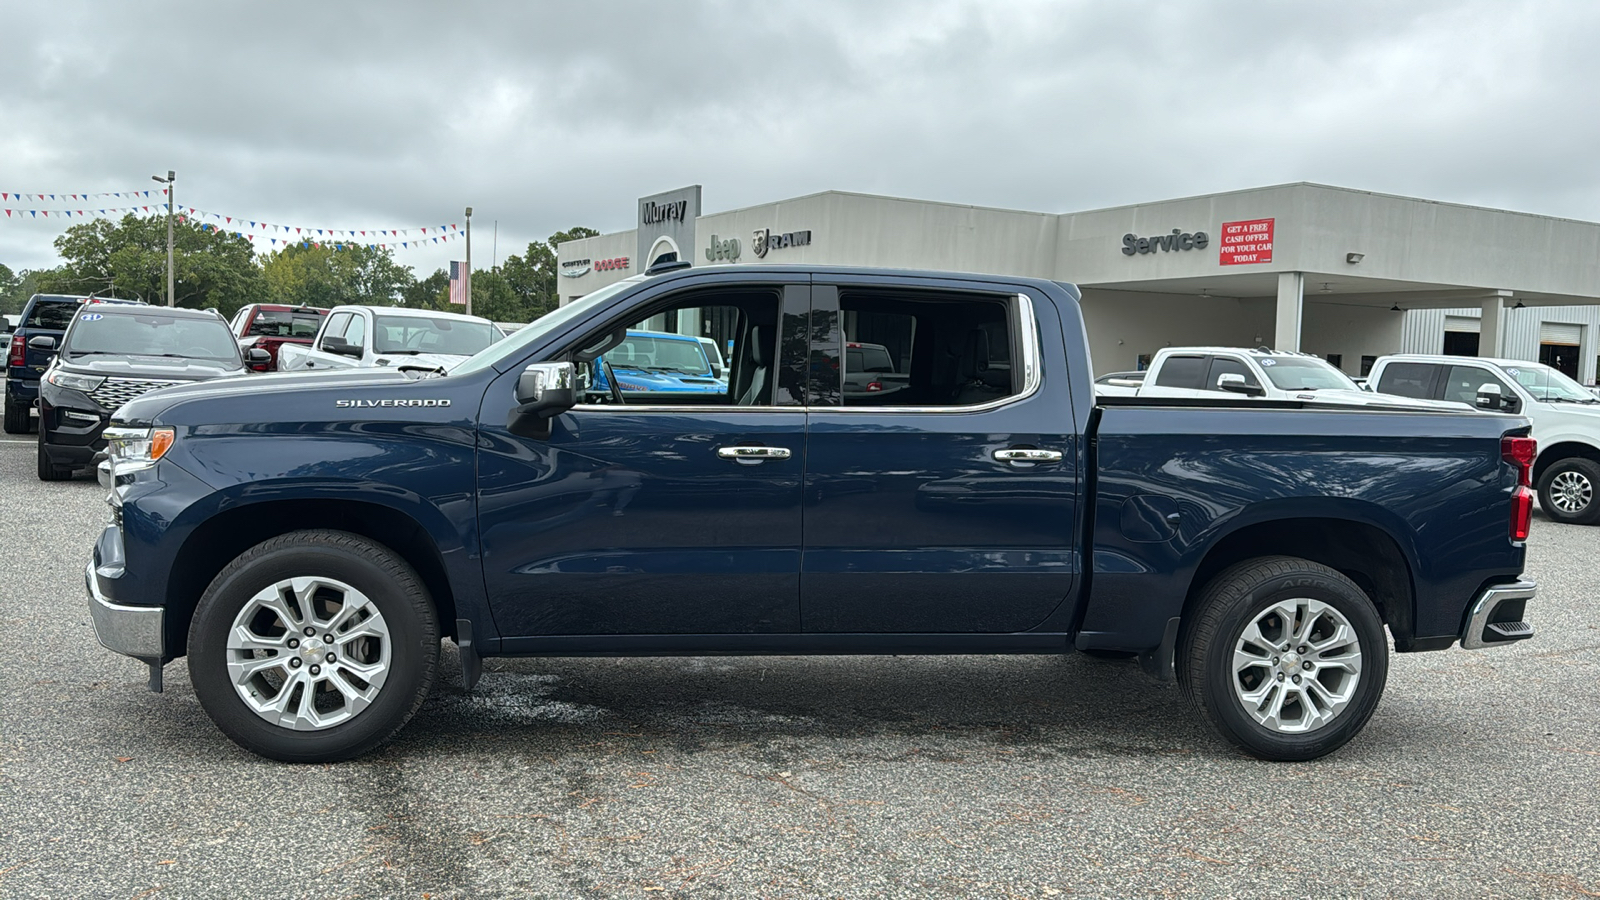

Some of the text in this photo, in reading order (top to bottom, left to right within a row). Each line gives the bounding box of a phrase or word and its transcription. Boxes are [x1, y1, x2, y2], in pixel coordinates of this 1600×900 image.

[642, 200, 687, 225] Murray
[1249, 223, 1268, 232] FREE
[767, 230, 811, 249] RAM
[1122, 228, 1209, 256] Service
[1225, 233, 1269, 243] CASH OFFER
[706, 234, 741, 263] Jeep
[1236, 244, 1256, 252] YOUR
[1257, 243, 1272, 251] CAR
[594, 257, 629, 271] DODGE
[1233, 254, 1258, 262] TODAY
[336, 399, 451, 408] SILVERADO
